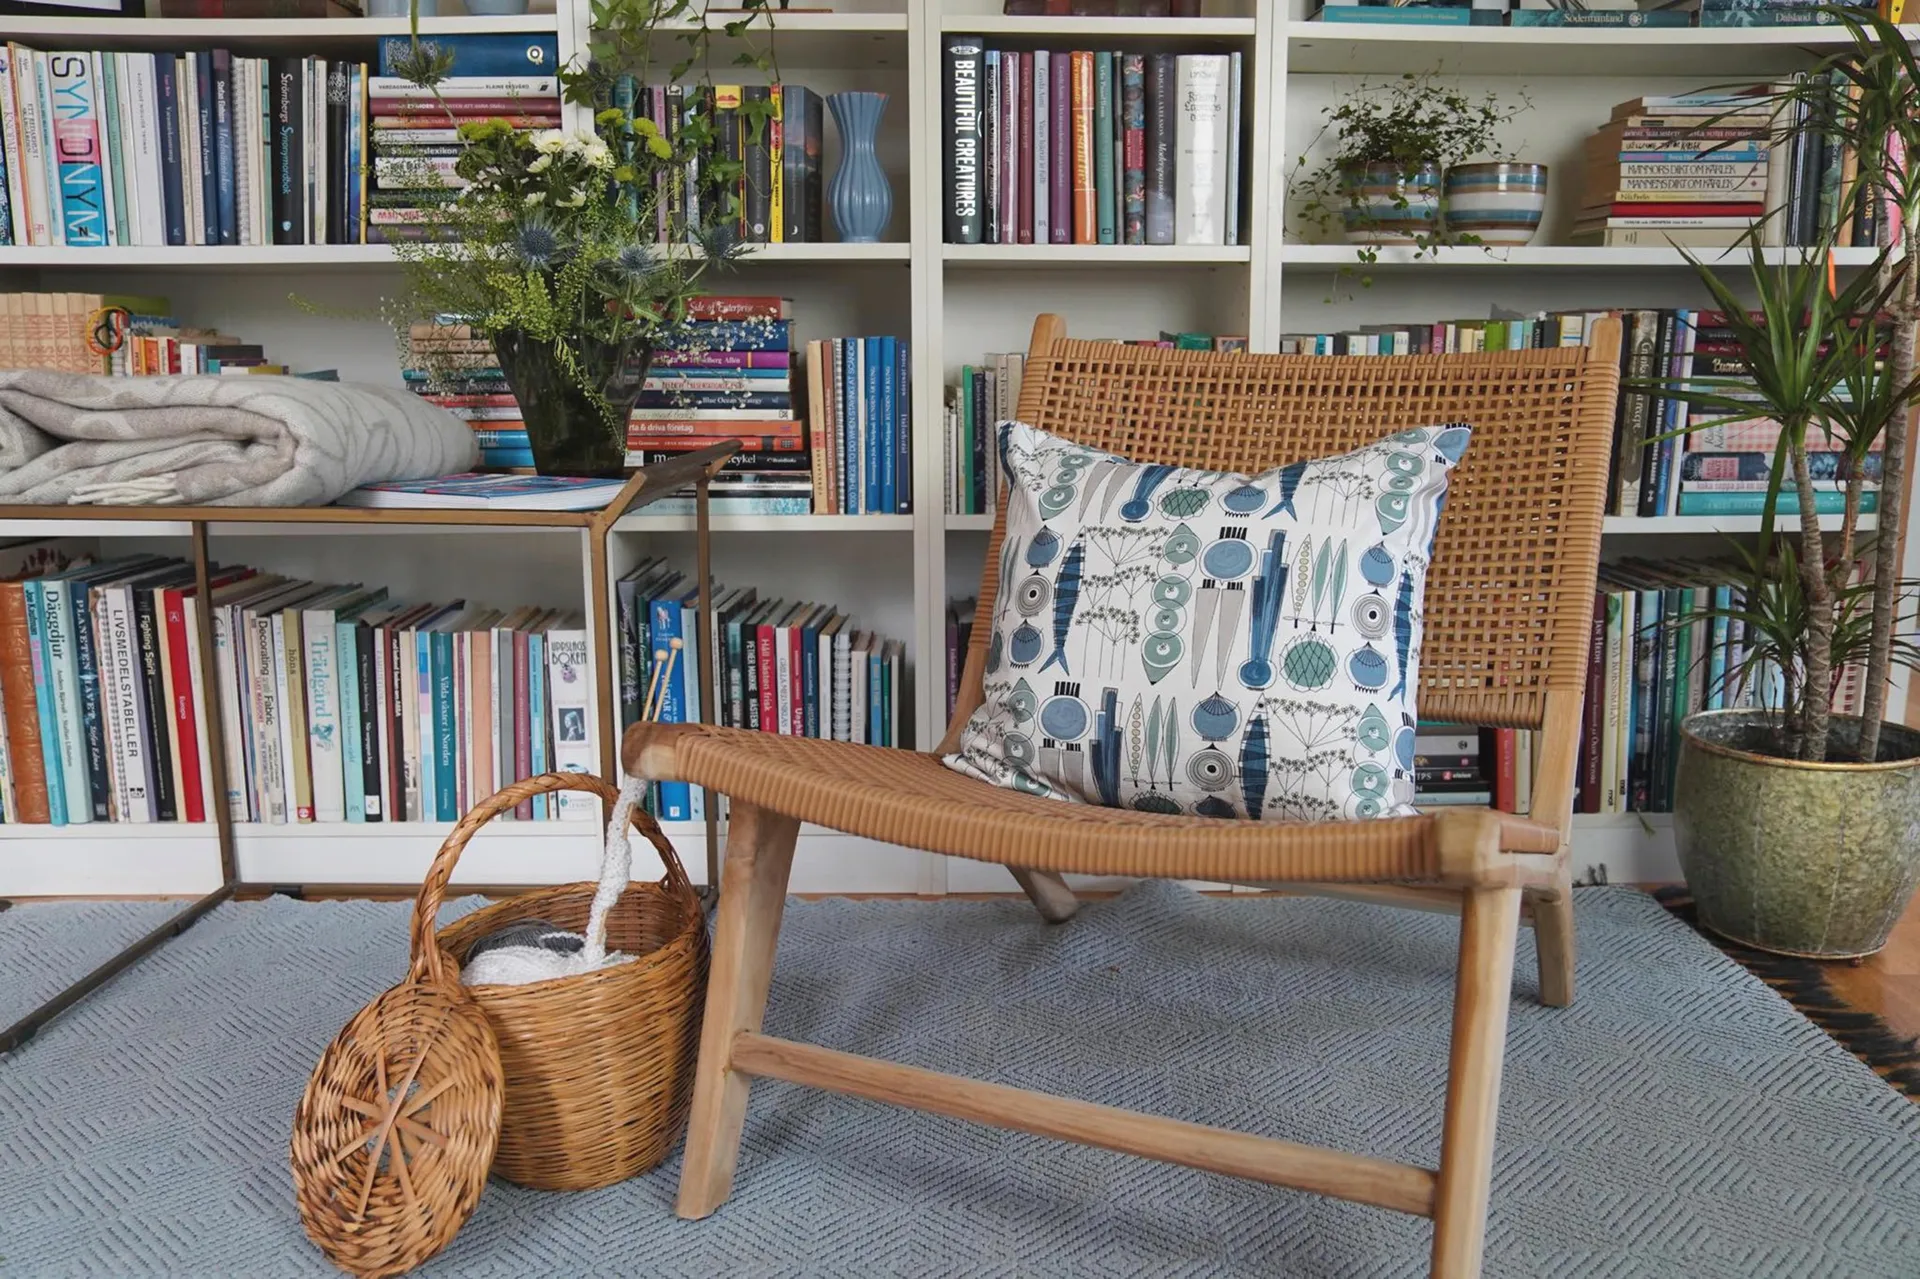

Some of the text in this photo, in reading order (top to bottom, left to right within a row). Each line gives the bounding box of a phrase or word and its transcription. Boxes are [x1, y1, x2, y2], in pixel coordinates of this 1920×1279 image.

[1563, 12, 1624, 23] Södermanland
[1775, 13, 1811, 22] Dalsland
[280, 73, 294, 194] Strömbergs Synonymordbok
[954, 60, 976, 217] BEAUTIFUL CREATURES
[847, 342, 855, 374] SCANDIC
[848, 386, 856, 416] STAYING
[647, 423, 666, 432] driva
[666, 422, 694, 433] företag
[848, 416, 856, 439] WHEN
[848, 440, 856, 452] DO
[848, 453, 856, 463] TO
[848, 464, 856, 490] THINGS
[26, 590, 35, 603] Joe
[46, 590, 66, 660] Däggdjur
[76, 600, 90, 670] PLANETEN
[140, 614, 156, 676] Fighting Spirit
[552, 652, 587, 665] BOKEN
[746, 640, 756, 664] PETHER
[1594, 636, 1604, 664] HEDH
[258, 620, 270, 676] Decorating
[264, 694, 275, 726] Fabric
[288, 648, 298, 674] höns
[760, 638, 772, 712] Håll hästen frisk
[1666, 649, 1677, 680] kokbok
[113, 610, 138, 758] LIVSMEDELSTABELLER
[308, 635, 332, 718] Trädgård
[440, 676, 450, 698] Vilda
[178, 696, 187, 720] Europa
[440, 700, 449, 726] växter
[750, 698, 760, 728] HÄSTENS
[442, 733, 451, 766] Norden
